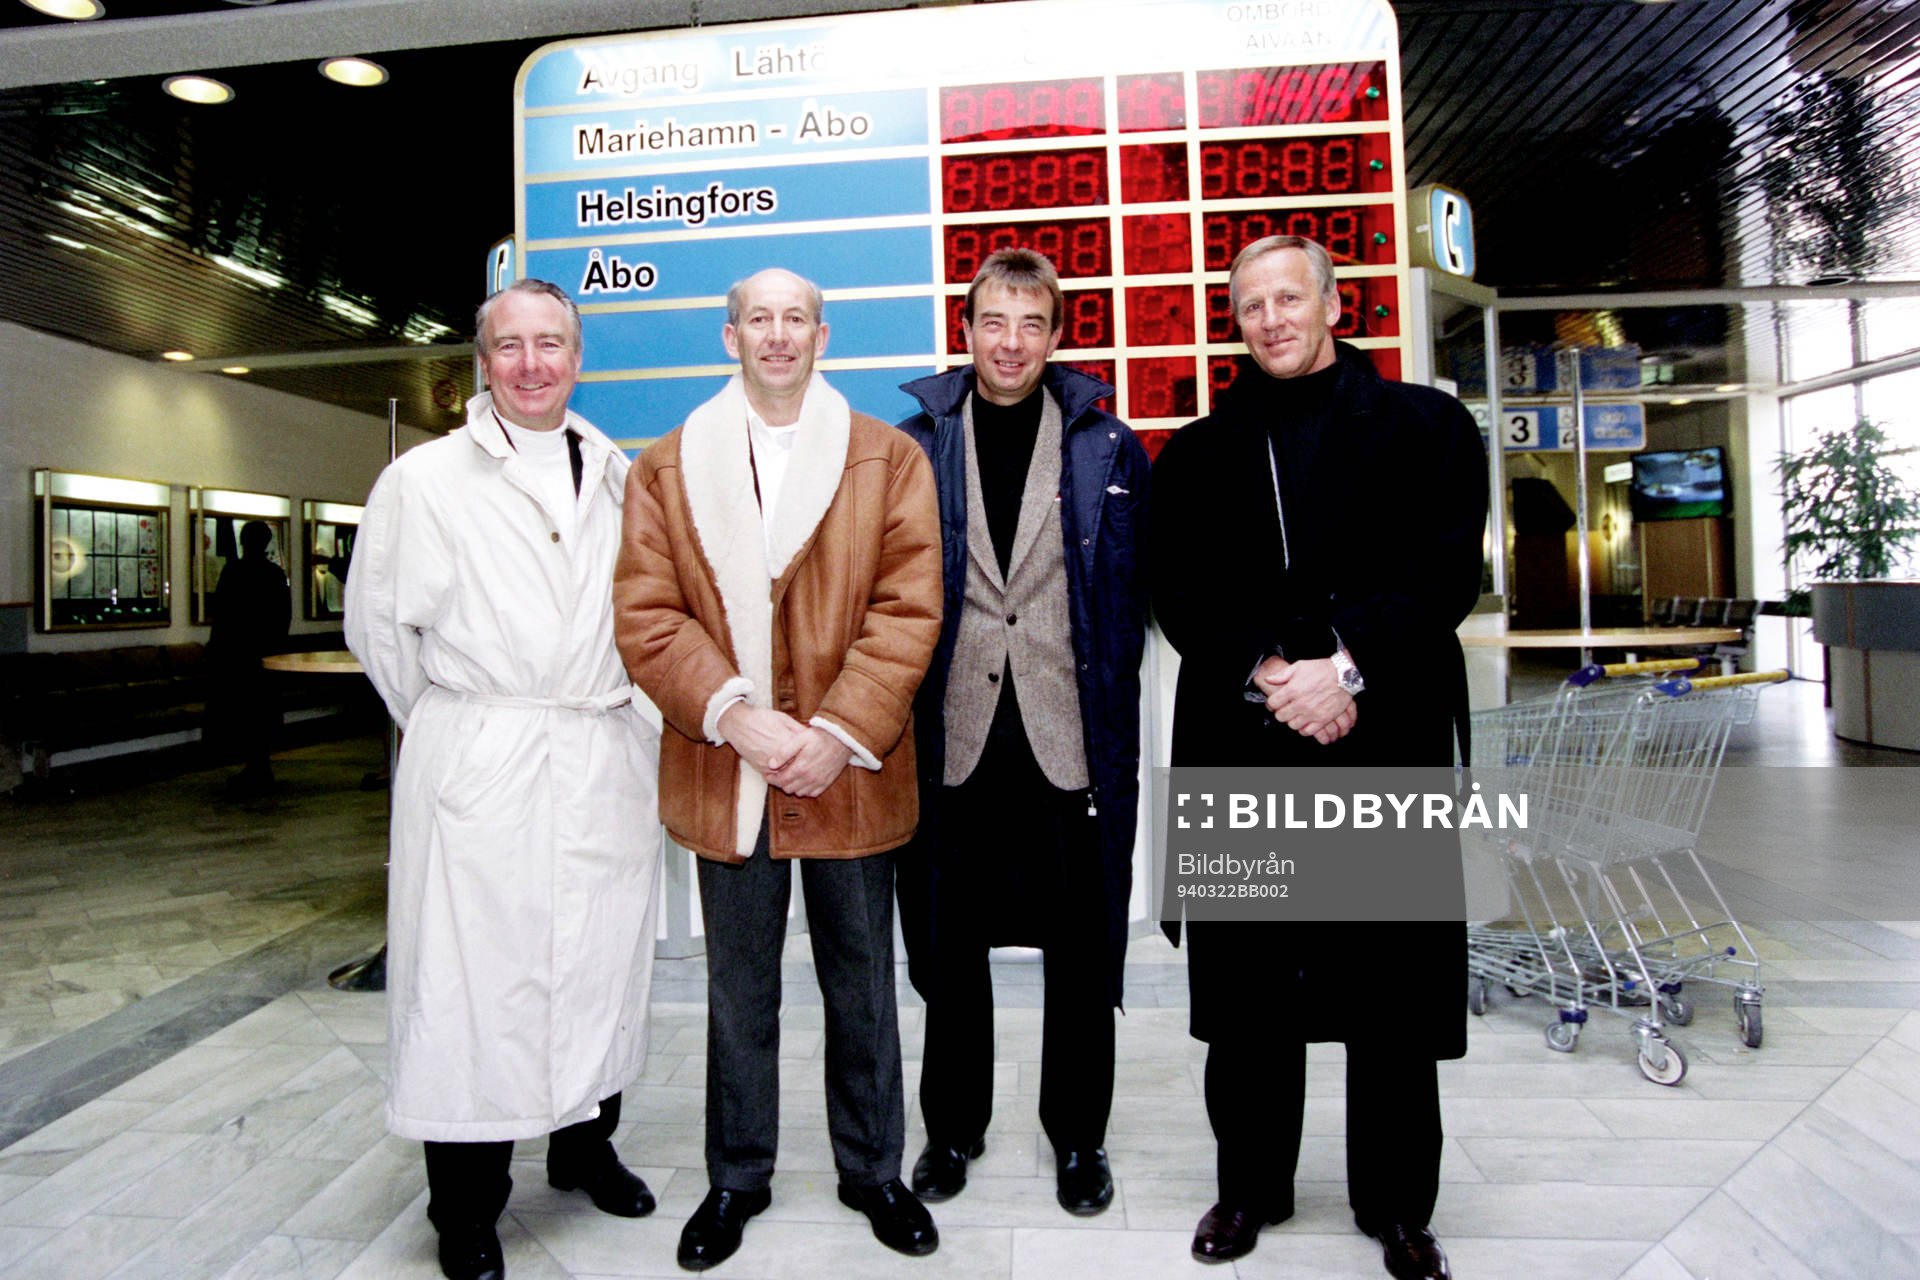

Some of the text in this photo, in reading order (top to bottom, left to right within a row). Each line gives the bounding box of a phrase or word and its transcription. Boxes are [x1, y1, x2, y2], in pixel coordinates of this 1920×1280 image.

[583, 61, 699, 93] Avgang
[579, 121, 756, 155] Mariehamn
[580, 186, 775, 223] Helsingfors
[583, 251, 655, 290] Åbo
[1510, 416, 1530, 443] 3
